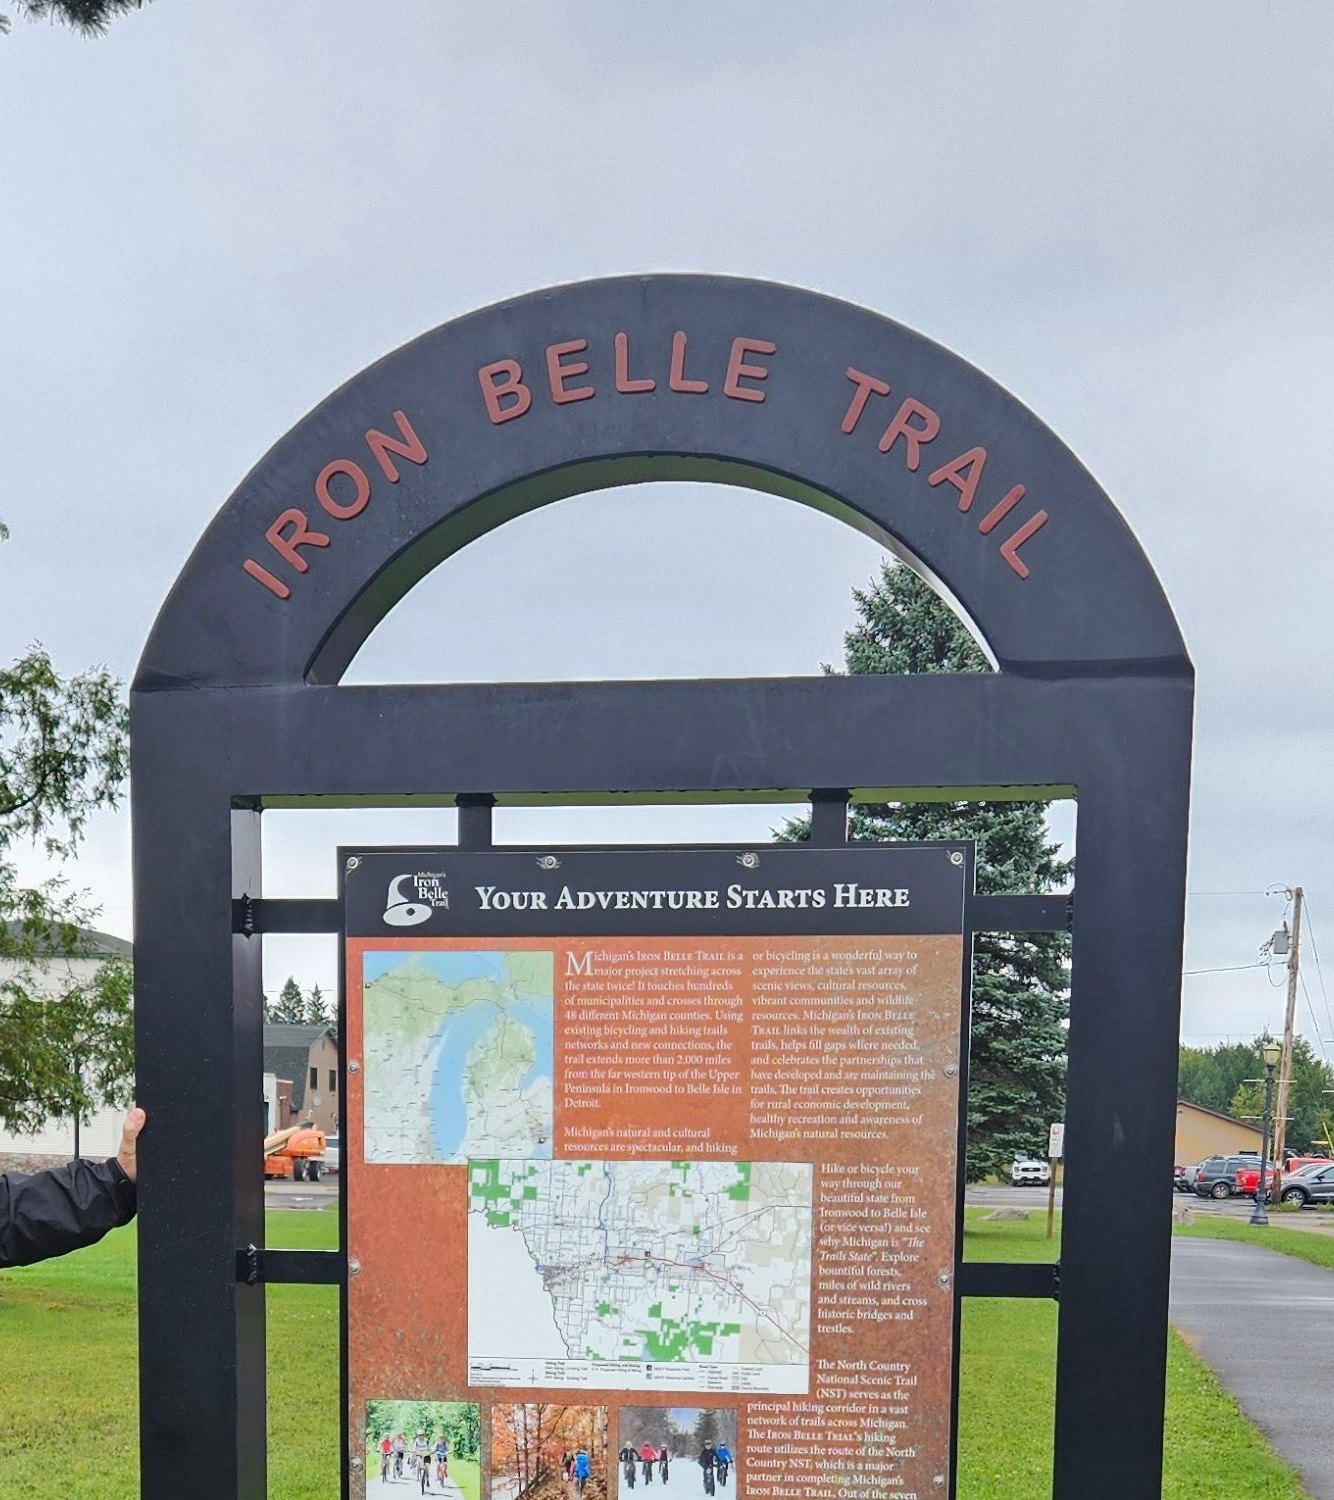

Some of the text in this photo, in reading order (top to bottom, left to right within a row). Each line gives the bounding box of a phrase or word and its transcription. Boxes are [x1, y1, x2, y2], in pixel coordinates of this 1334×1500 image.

[243, 332, 1048, 599] IRON BELLE TRAIL
[413, 875, 440, 887] Iron
[418, 887, 448, 899] Belle
[474, 883, 910, 910] YOUR ADVENTURE STARTS HERE
[592, 967, 622, 978] major
[625, 967, 658, 978] project
[661, 966, 708, 978] stretching
[565, 980, 580, 990] the
[583, 982, 604, 990] state
[638, 980, 644, 990] It
[648, 980, 684, 990] touches
[687, 980, 733, 990] hundreds
[564, 995, 574, 1004] of
[577, 995, 644, 1007] municipalities
[647, 995, 665, 1004] and
[704, 995, 742, 1007] through
[564, 1025, 727, 1037] existing bicycling and hiking trails
[565, 1083, 741, 1093] Peninsula in Ironwood to Belle Isle in
[822, 1163, 845, 1173] Hike
[861, 1164, 894, 1176] bicycle
[897, 1167, 919, 1176] your
[821, 1181, 840, 1190] way
[842, 1178, 882, 1190] through
[821, 1207, 927, 1217] Ironwood to Belle Isle
[818, 1294, 836, 1304] and
[839, 1296, 879, 1306] streams,
[881, 1295, 900, 1305] and
[818, 1359, 910, 1373] The North Country
[817, 1374, 917, 1385] National Scenic Trail
[816, 1388, 846, 1401] (NST)
[893, 1389, 909, 1399] the
